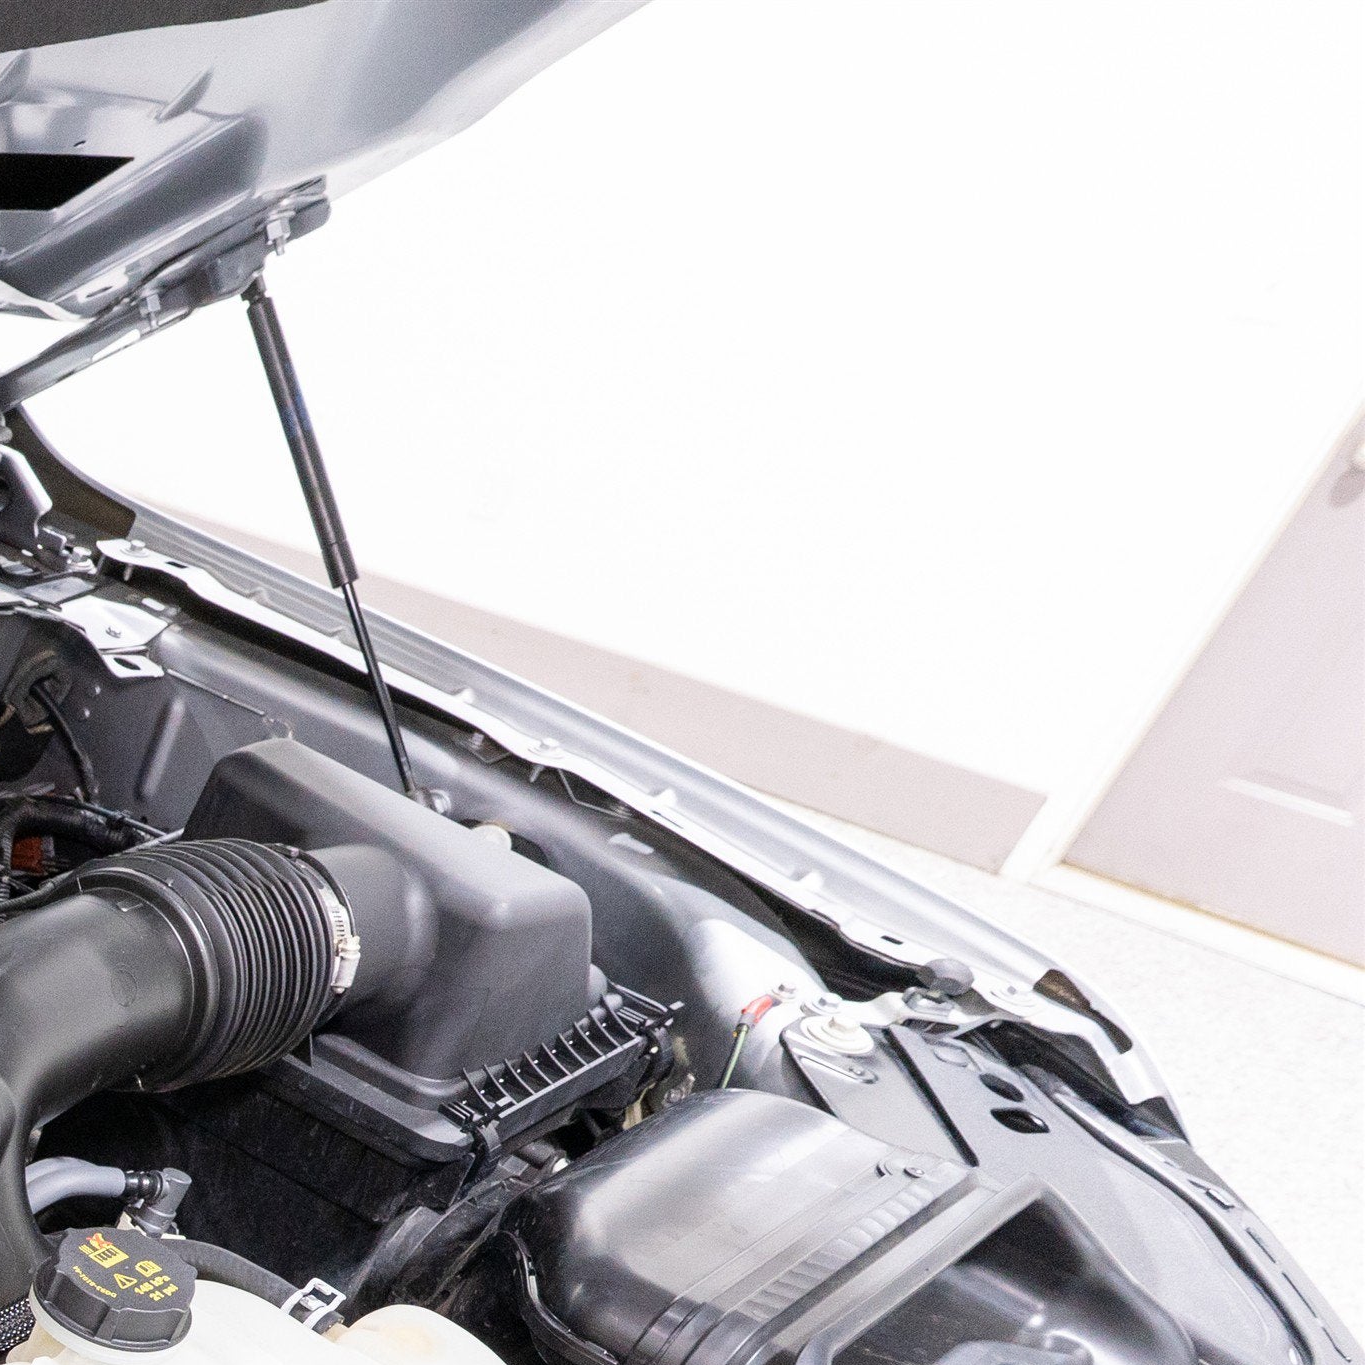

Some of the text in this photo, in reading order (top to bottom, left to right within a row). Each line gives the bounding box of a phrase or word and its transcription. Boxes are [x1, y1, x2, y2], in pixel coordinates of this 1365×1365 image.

[150, 1275, 171, 1289] kPa
[149, 1284, 179, 1301] 21 psi
